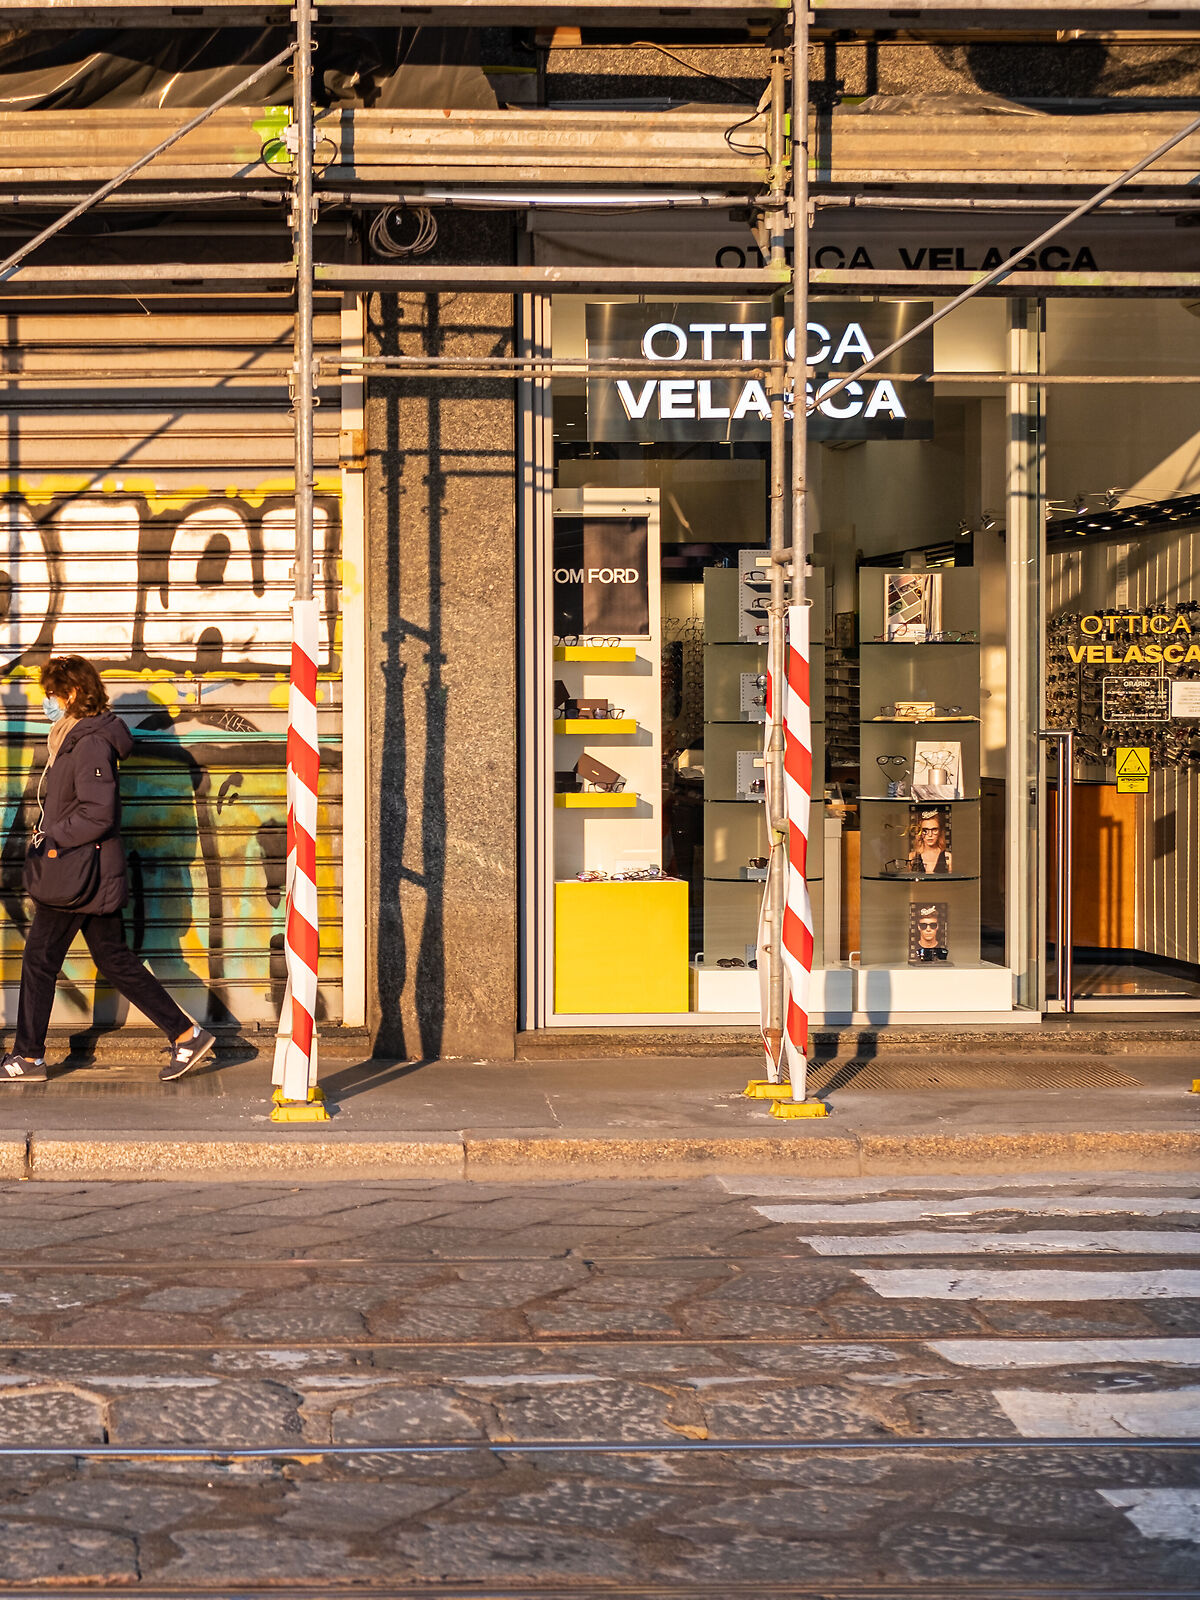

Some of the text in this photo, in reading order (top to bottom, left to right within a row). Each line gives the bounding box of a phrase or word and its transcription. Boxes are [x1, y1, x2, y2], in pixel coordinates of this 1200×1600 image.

[641, 321, 876, 365] OTTCA
[553, 568, 639, 584] OM FORD
[1080, 615, 1192, 635] OTTICA
[1067, 644, 1200, 664] VELASCA
